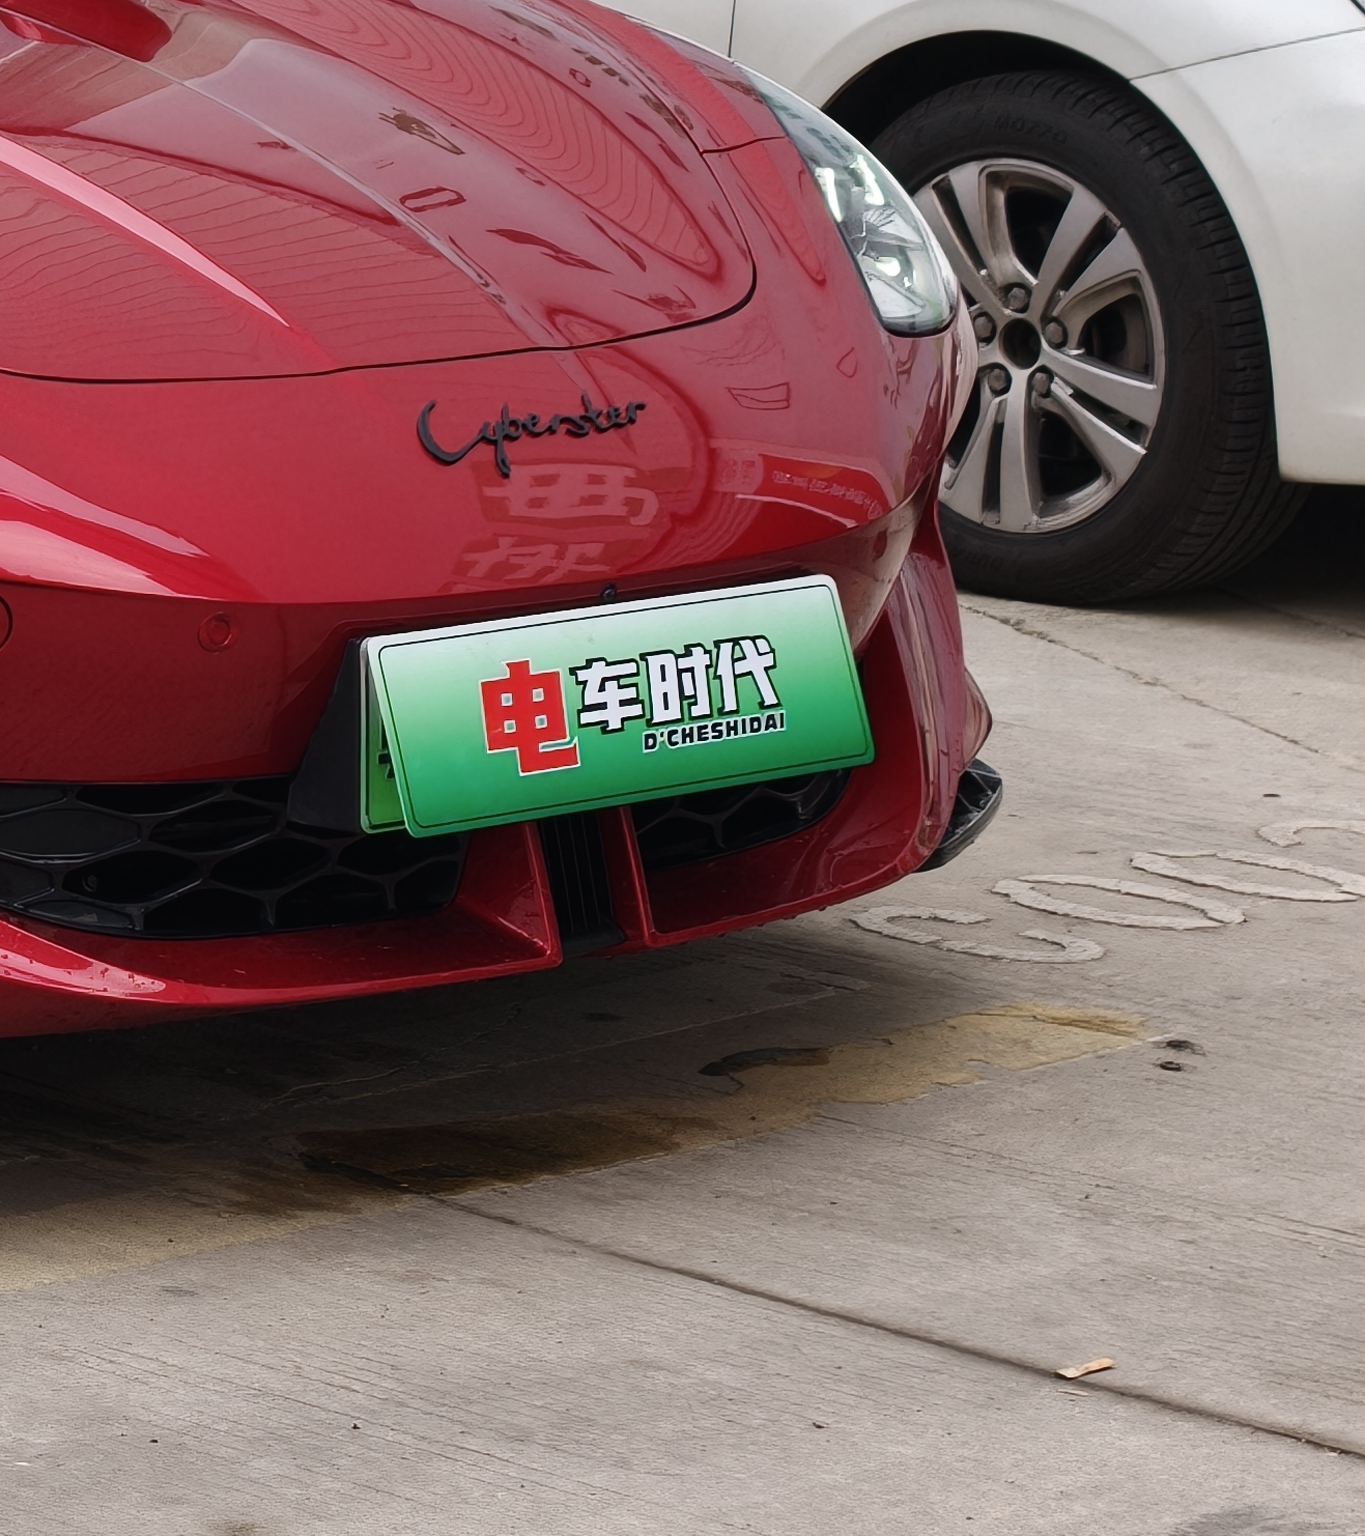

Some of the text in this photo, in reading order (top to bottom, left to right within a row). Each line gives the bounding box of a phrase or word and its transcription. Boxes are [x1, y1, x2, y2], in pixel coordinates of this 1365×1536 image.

[416, 389, 647, 479] Cyberster
[477, 636, 782, 778] 电车时代
[643, 710, 786, 753] D'CHESHIDAI
